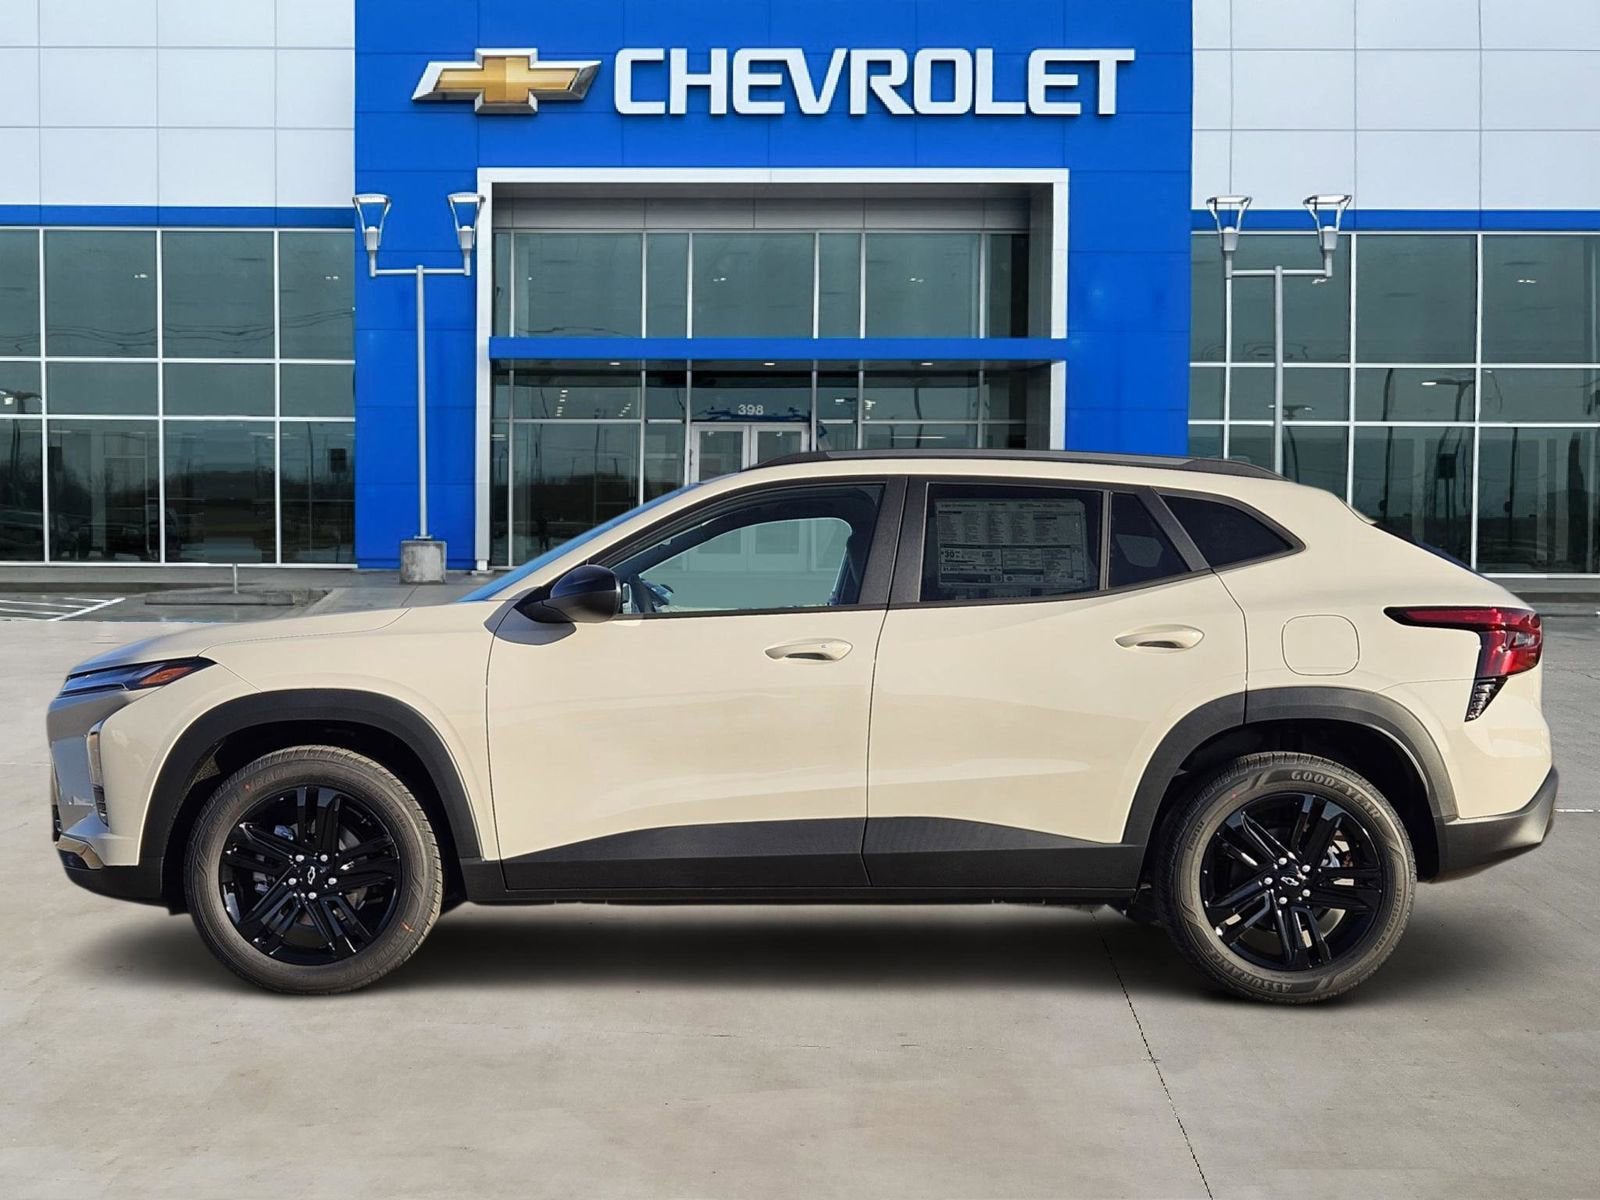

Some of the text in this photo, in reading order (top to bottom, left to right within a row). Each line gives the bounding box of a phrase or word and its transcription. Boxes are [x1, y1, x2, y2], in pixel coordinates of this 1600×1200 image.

[614, 47, 1136, 115] CHEVROLET
[738, 404, 764, 415] 398
[1291, 770, 1381, 819] GOODYEAR
